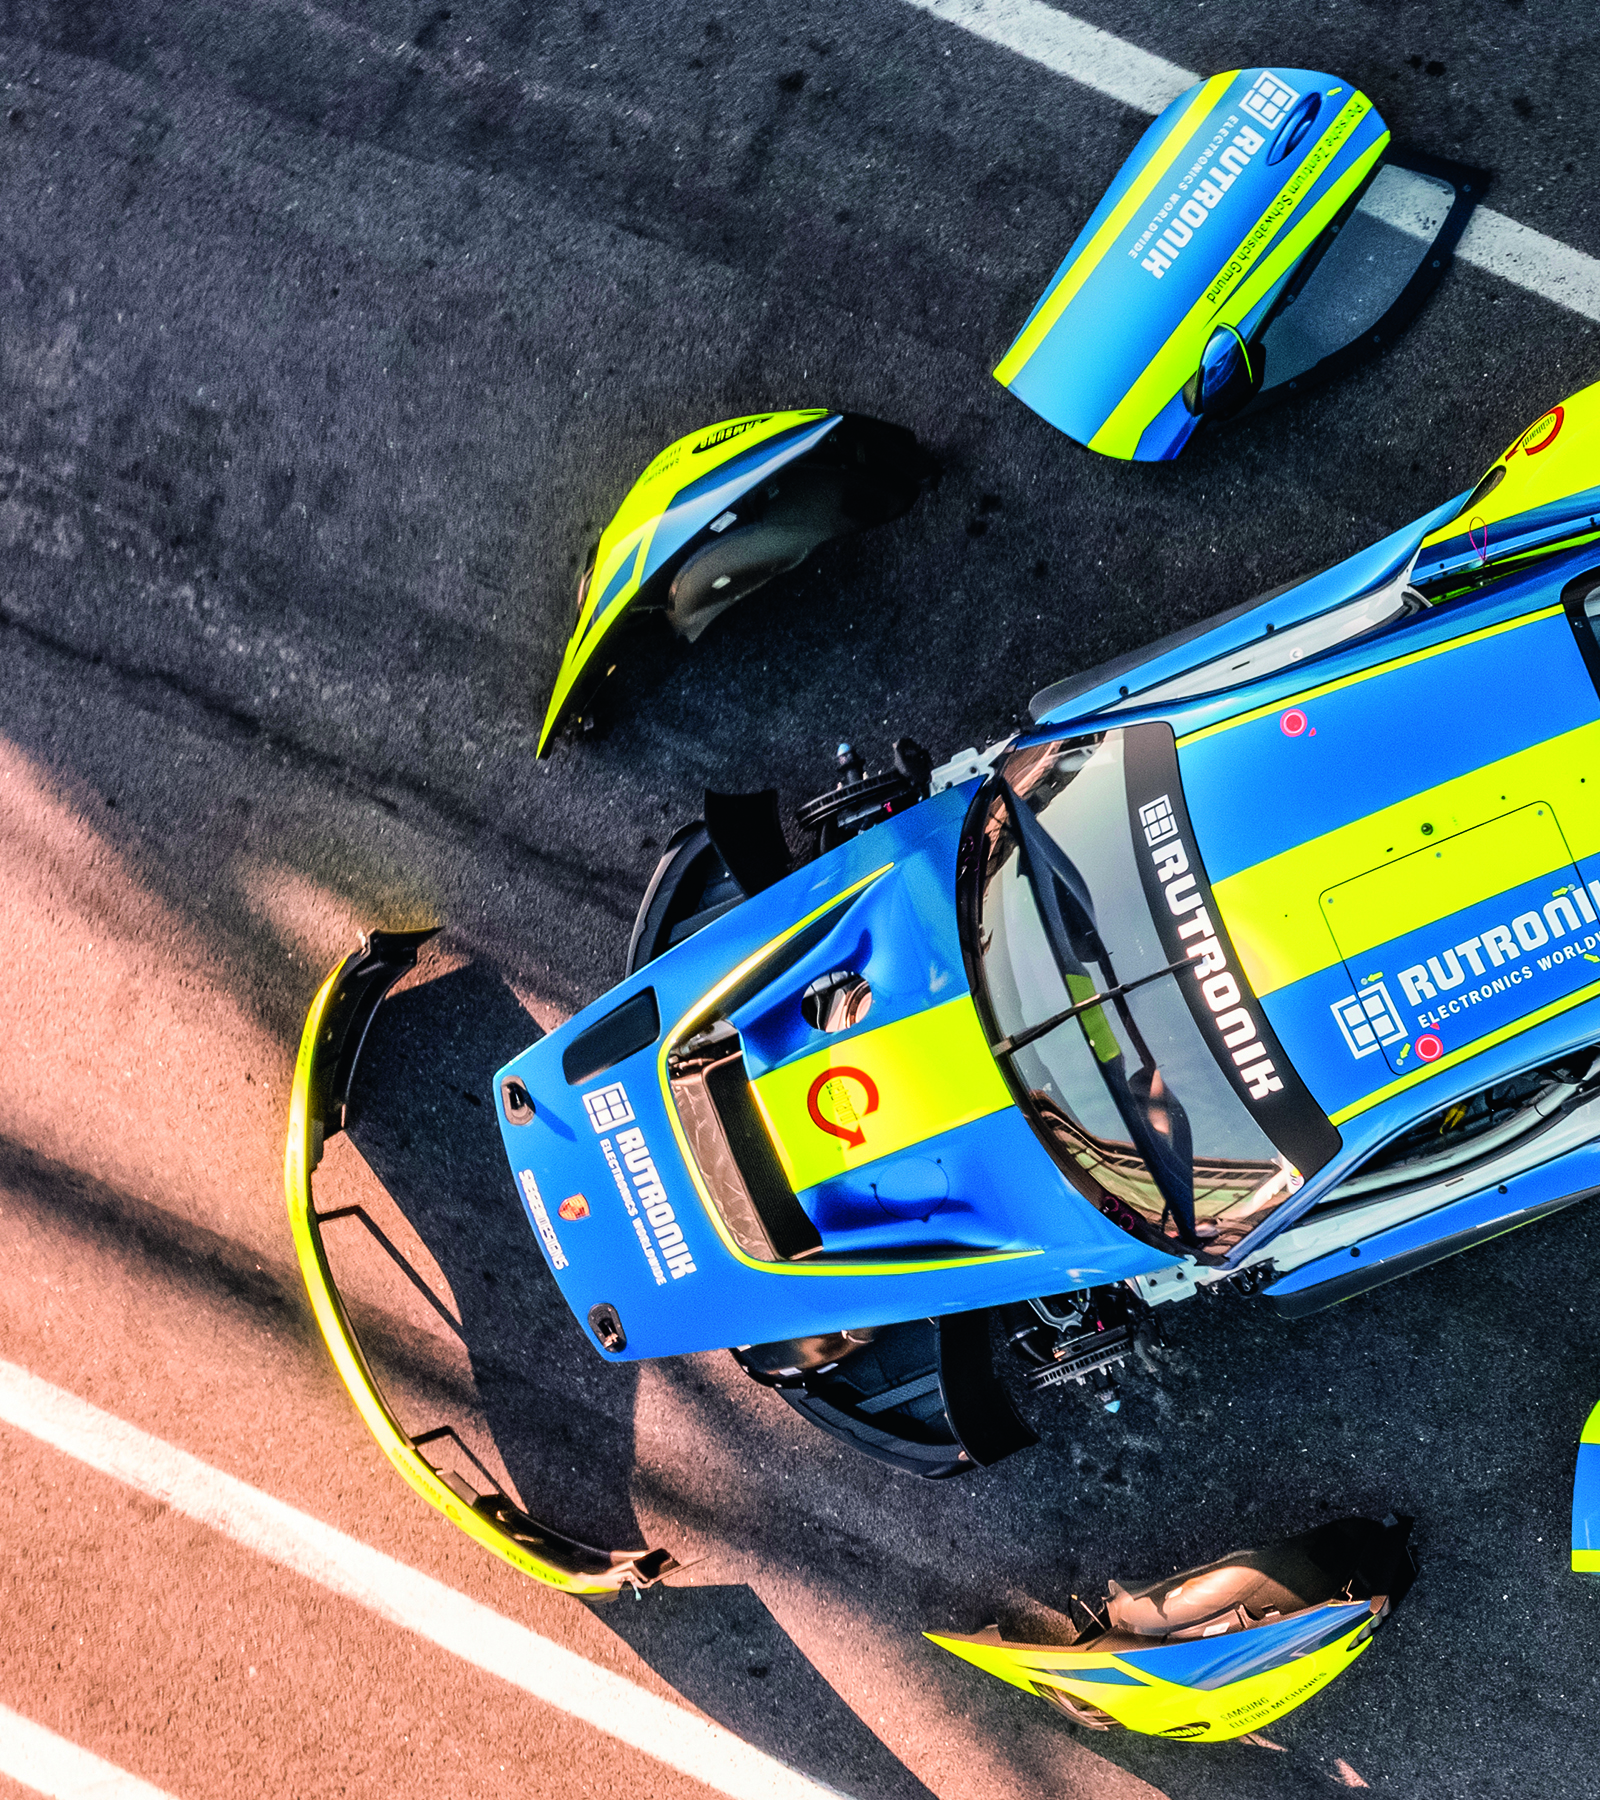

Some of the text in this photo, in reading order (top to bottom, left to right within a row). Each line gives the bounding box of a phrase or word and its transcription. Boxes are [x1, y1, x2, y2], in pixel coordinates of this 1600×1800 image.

[1128, 115, 1239, 260] ELECTRONICS WORLDWIDE
[1140, 124, 1266, 280] RUTRONIK
[1287, 146, 1330, 195] Zentrum
[1151, 838, 1285, 1101] RUTRONIK
[1417, 965, 1533, 1029] ELECTRONICS
[600, 1138, 639, 1217] ELECTRONICS
[615, 1126, 698, 1280] RUTRONIK
[1219, 1696, 1270, 1722] SAMSUNG
